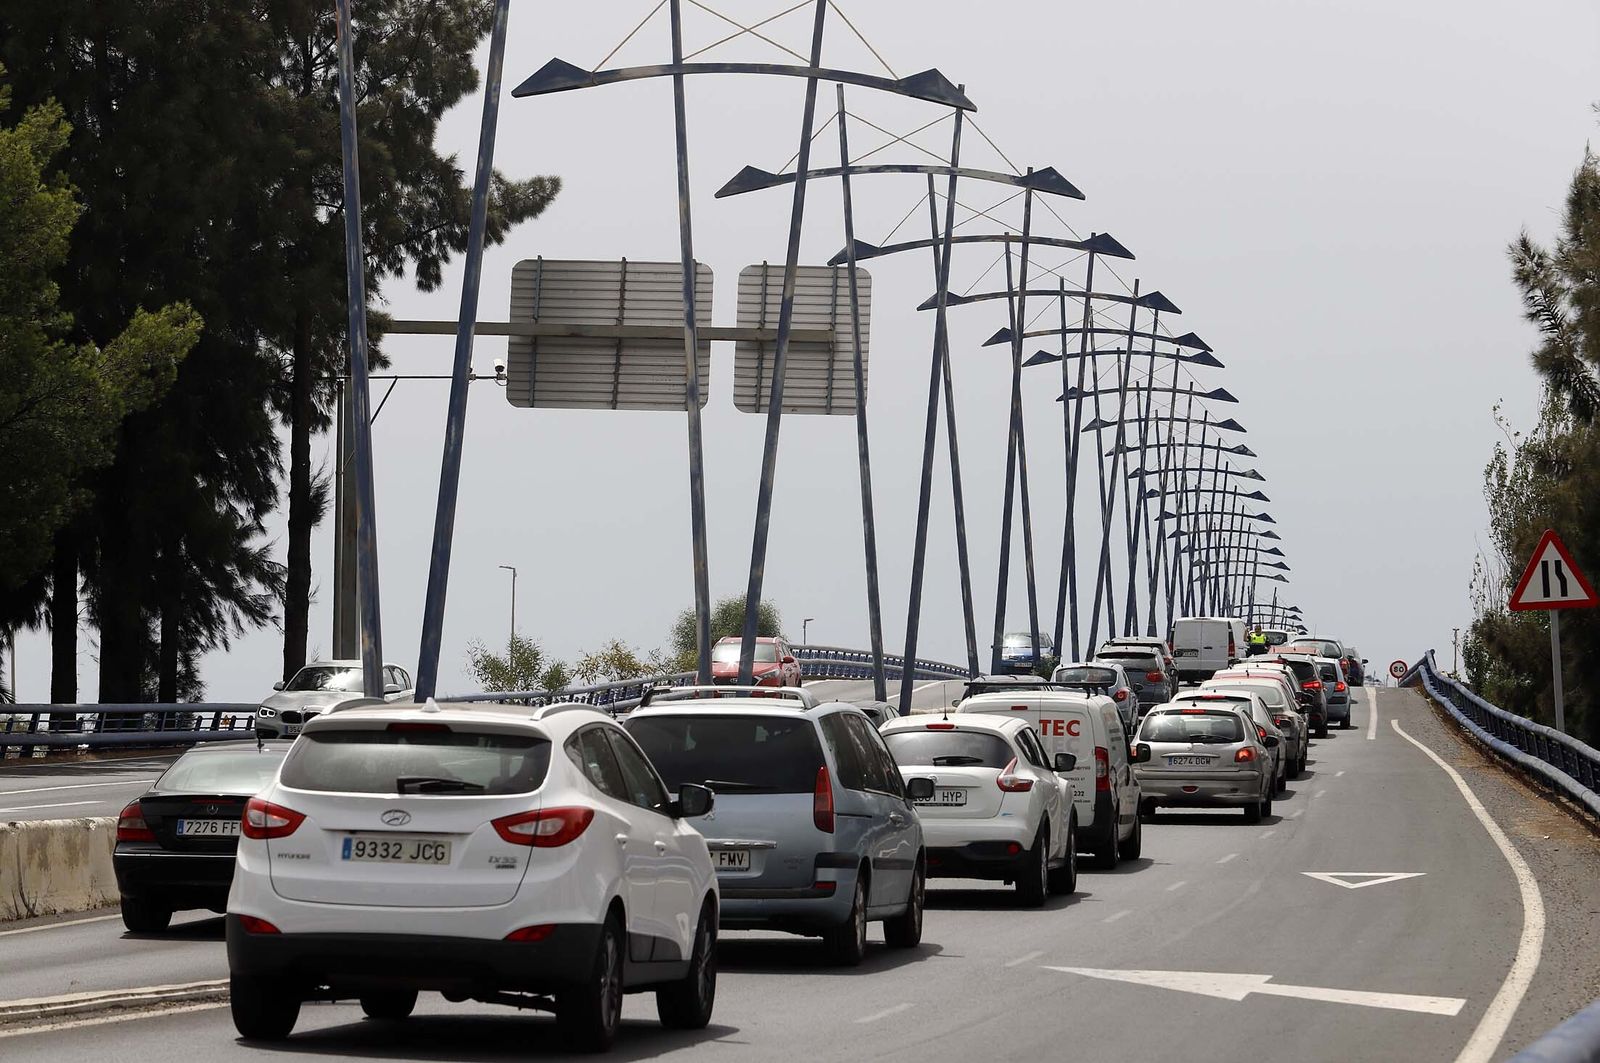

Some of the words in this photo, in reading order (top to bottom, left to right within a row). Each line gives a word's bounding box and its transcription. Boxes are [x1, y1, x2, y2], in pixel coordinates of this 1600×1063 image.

[1039, 720, 1080, 736] TEC
[942, 791, 963, 802] HYP
[186, 821, 218, 834] 7276
[222, 821, 242, 834] FF
[355, 841, 403, 860] 9332
[410, 843, 446, 861] JCG
[719, 852, 745, 866] FMV
